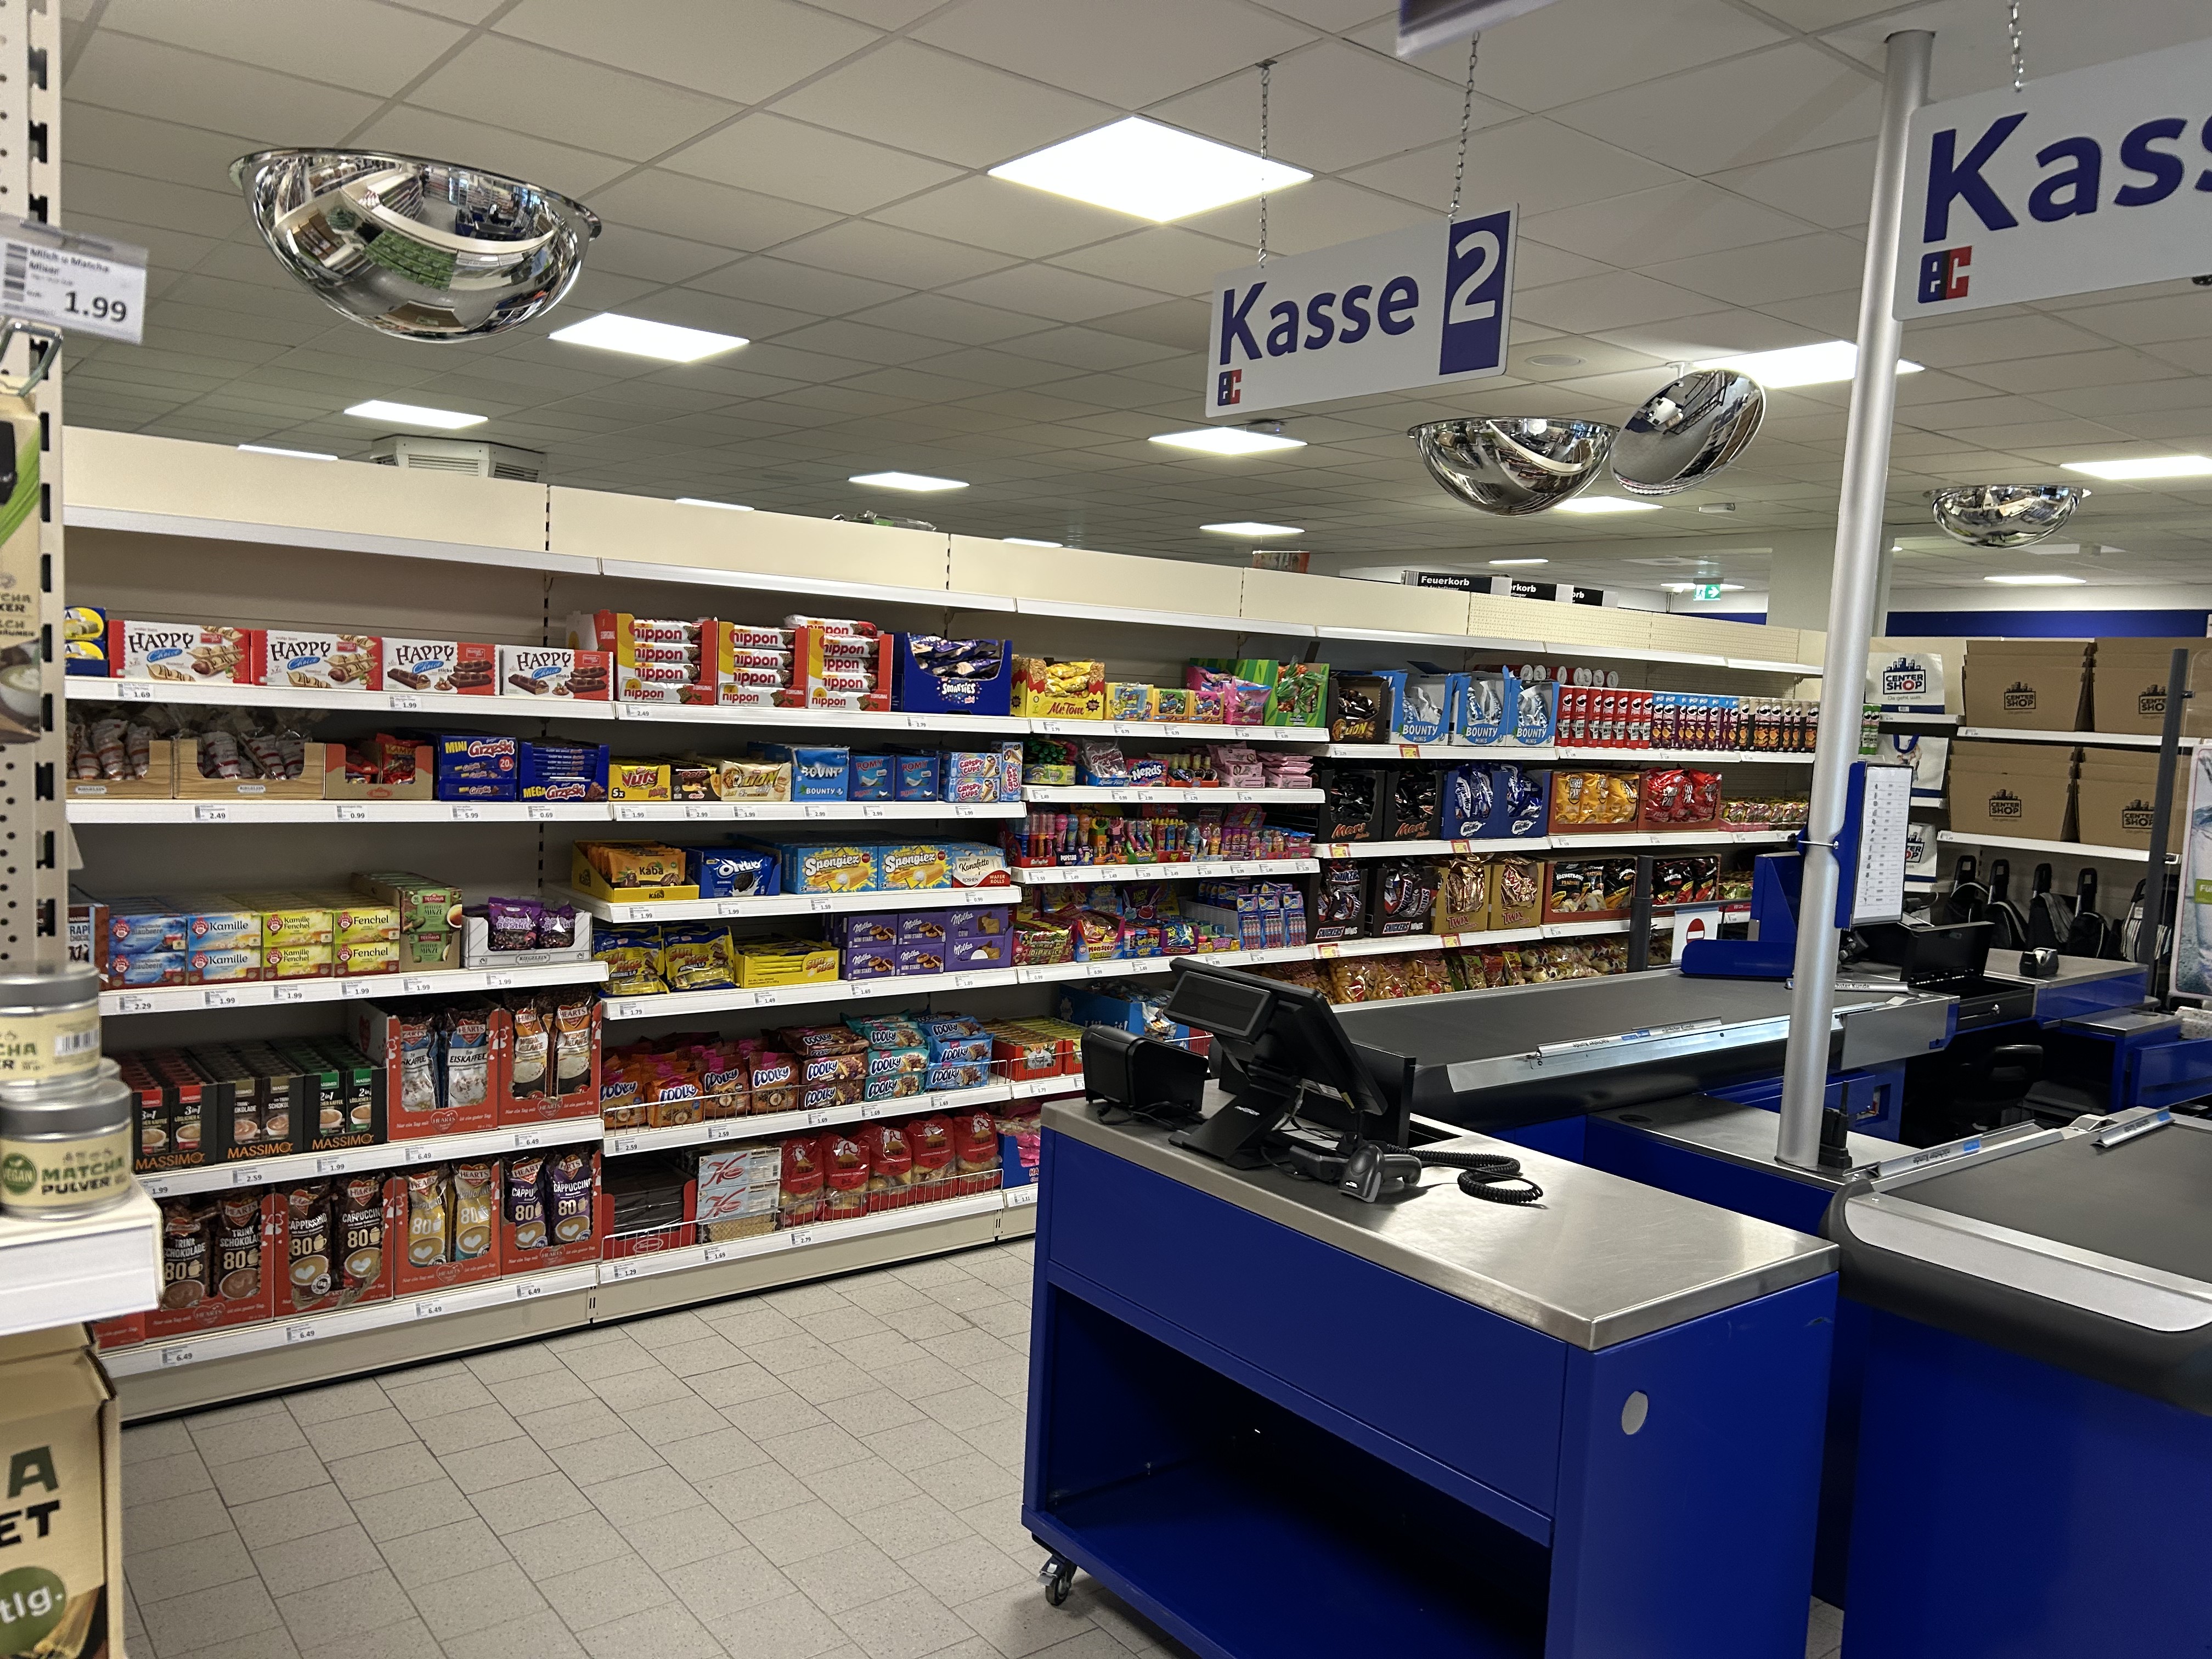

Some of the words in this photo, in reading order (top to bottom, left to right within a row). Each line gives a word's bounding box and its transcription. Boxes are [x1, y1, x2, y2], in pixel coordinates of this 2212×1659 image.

[1923, 112, 2212, 243] Kas
[1220, 275, 1419, 365] Kasse
[1448, 230, 1499, 324] 2
[64, 291, 127, 323] 1.99
[1421, 576, 1470, 586] Feuerkorb
[128, 633, 194, 653] HAPPY
[270, 641, 331, 661] HAPPY
[396, 645, 454, 665] HAPPY
[517, 652, 571, 670] HAPPY
[941, 681, 977, 695] SMARTIES
[1887, 680, 1922, 691] SHOP
[624, 687, 664, 701] nippon
[722, 692, 759, 705] nippon
[812, 695, 847, 708] nippon
[1346, 722, 1367, 736] LION
[1402, 725, 1438, 736] BOUNTY
[1466, 726, 1498, 737] BOUNTY
[1516, 727, 1547, 738] BOUNTY
[445, 741, 467, 754] MINI
[856, 759, 883, 770] ROMY
[902, 760, 928, 771] ROMY
[959, 759, 983, 769] CRISPY
[622, 769, 659, 788] Nuts
[523, 786, 546, 798] MEGA
[612, 789, 624, 798] 5x
[957, 784, 982, 793] CRISPY
[1331, 823, 1366, 838] Mars
[1395, 822, 1427, 837] Mars
[805, 855, 860, 876] Spongiez
[885, 853, 936, 874] Spongiez
[640, 866, 664, 876] Kaba
[354, 915, 389, 925] Fenchel
[951, 912, 974, 926] Milka
[1447, 915, 1469, 930] Twix
[1503, 910, 1523, 924] Twix
[210, 920, 249, 932] Kamille
[853, 922, 873, 933] Milka
[903, 919, 922, 930] Milka
[1384, 923, 1410, 932] SNICKERS
[209, 953, 248, 964] Kamille
[353, 948, 388, 957] Fenchel
[853, 953, 872, 964] Milka
[901, 949, 920, 961] Milka
[560, 1008, 588, 1017] HEARTS
[458, 1025, 486, 1034] HEARTS
[450, 1053, 487, 1063] EISKAFFEE
[312, 1133, 374, 1150] MASSIMO
[228, 1142, 294, 1159] MASSIMO
[136, 1152, 205, 1170] MASSIMO
[42, 1157, 124, 1182] MATCHA
[460, 1170, 489, 1178] HEARTS
[41, 1176, 110, 1195] PULVER
[515, 1205, 534, 1221] 80
[558, 1200, 577, 1215] 80
[342, 1207, 382, 1223] CAPPUCCIN
[461, 1207, 477, 1224] 80
[232, 1226, 254, 1237] TRINK
[412, 1217, 431, 1234] 80
[175, 1238, 195, 1248] TRINK
[347, 1229, 369, 1248] 80
[292, 1238, 312, 1256] 80
[224, 1251, 245, 1269] 80
[165, 1263, 187, 1280] 80
